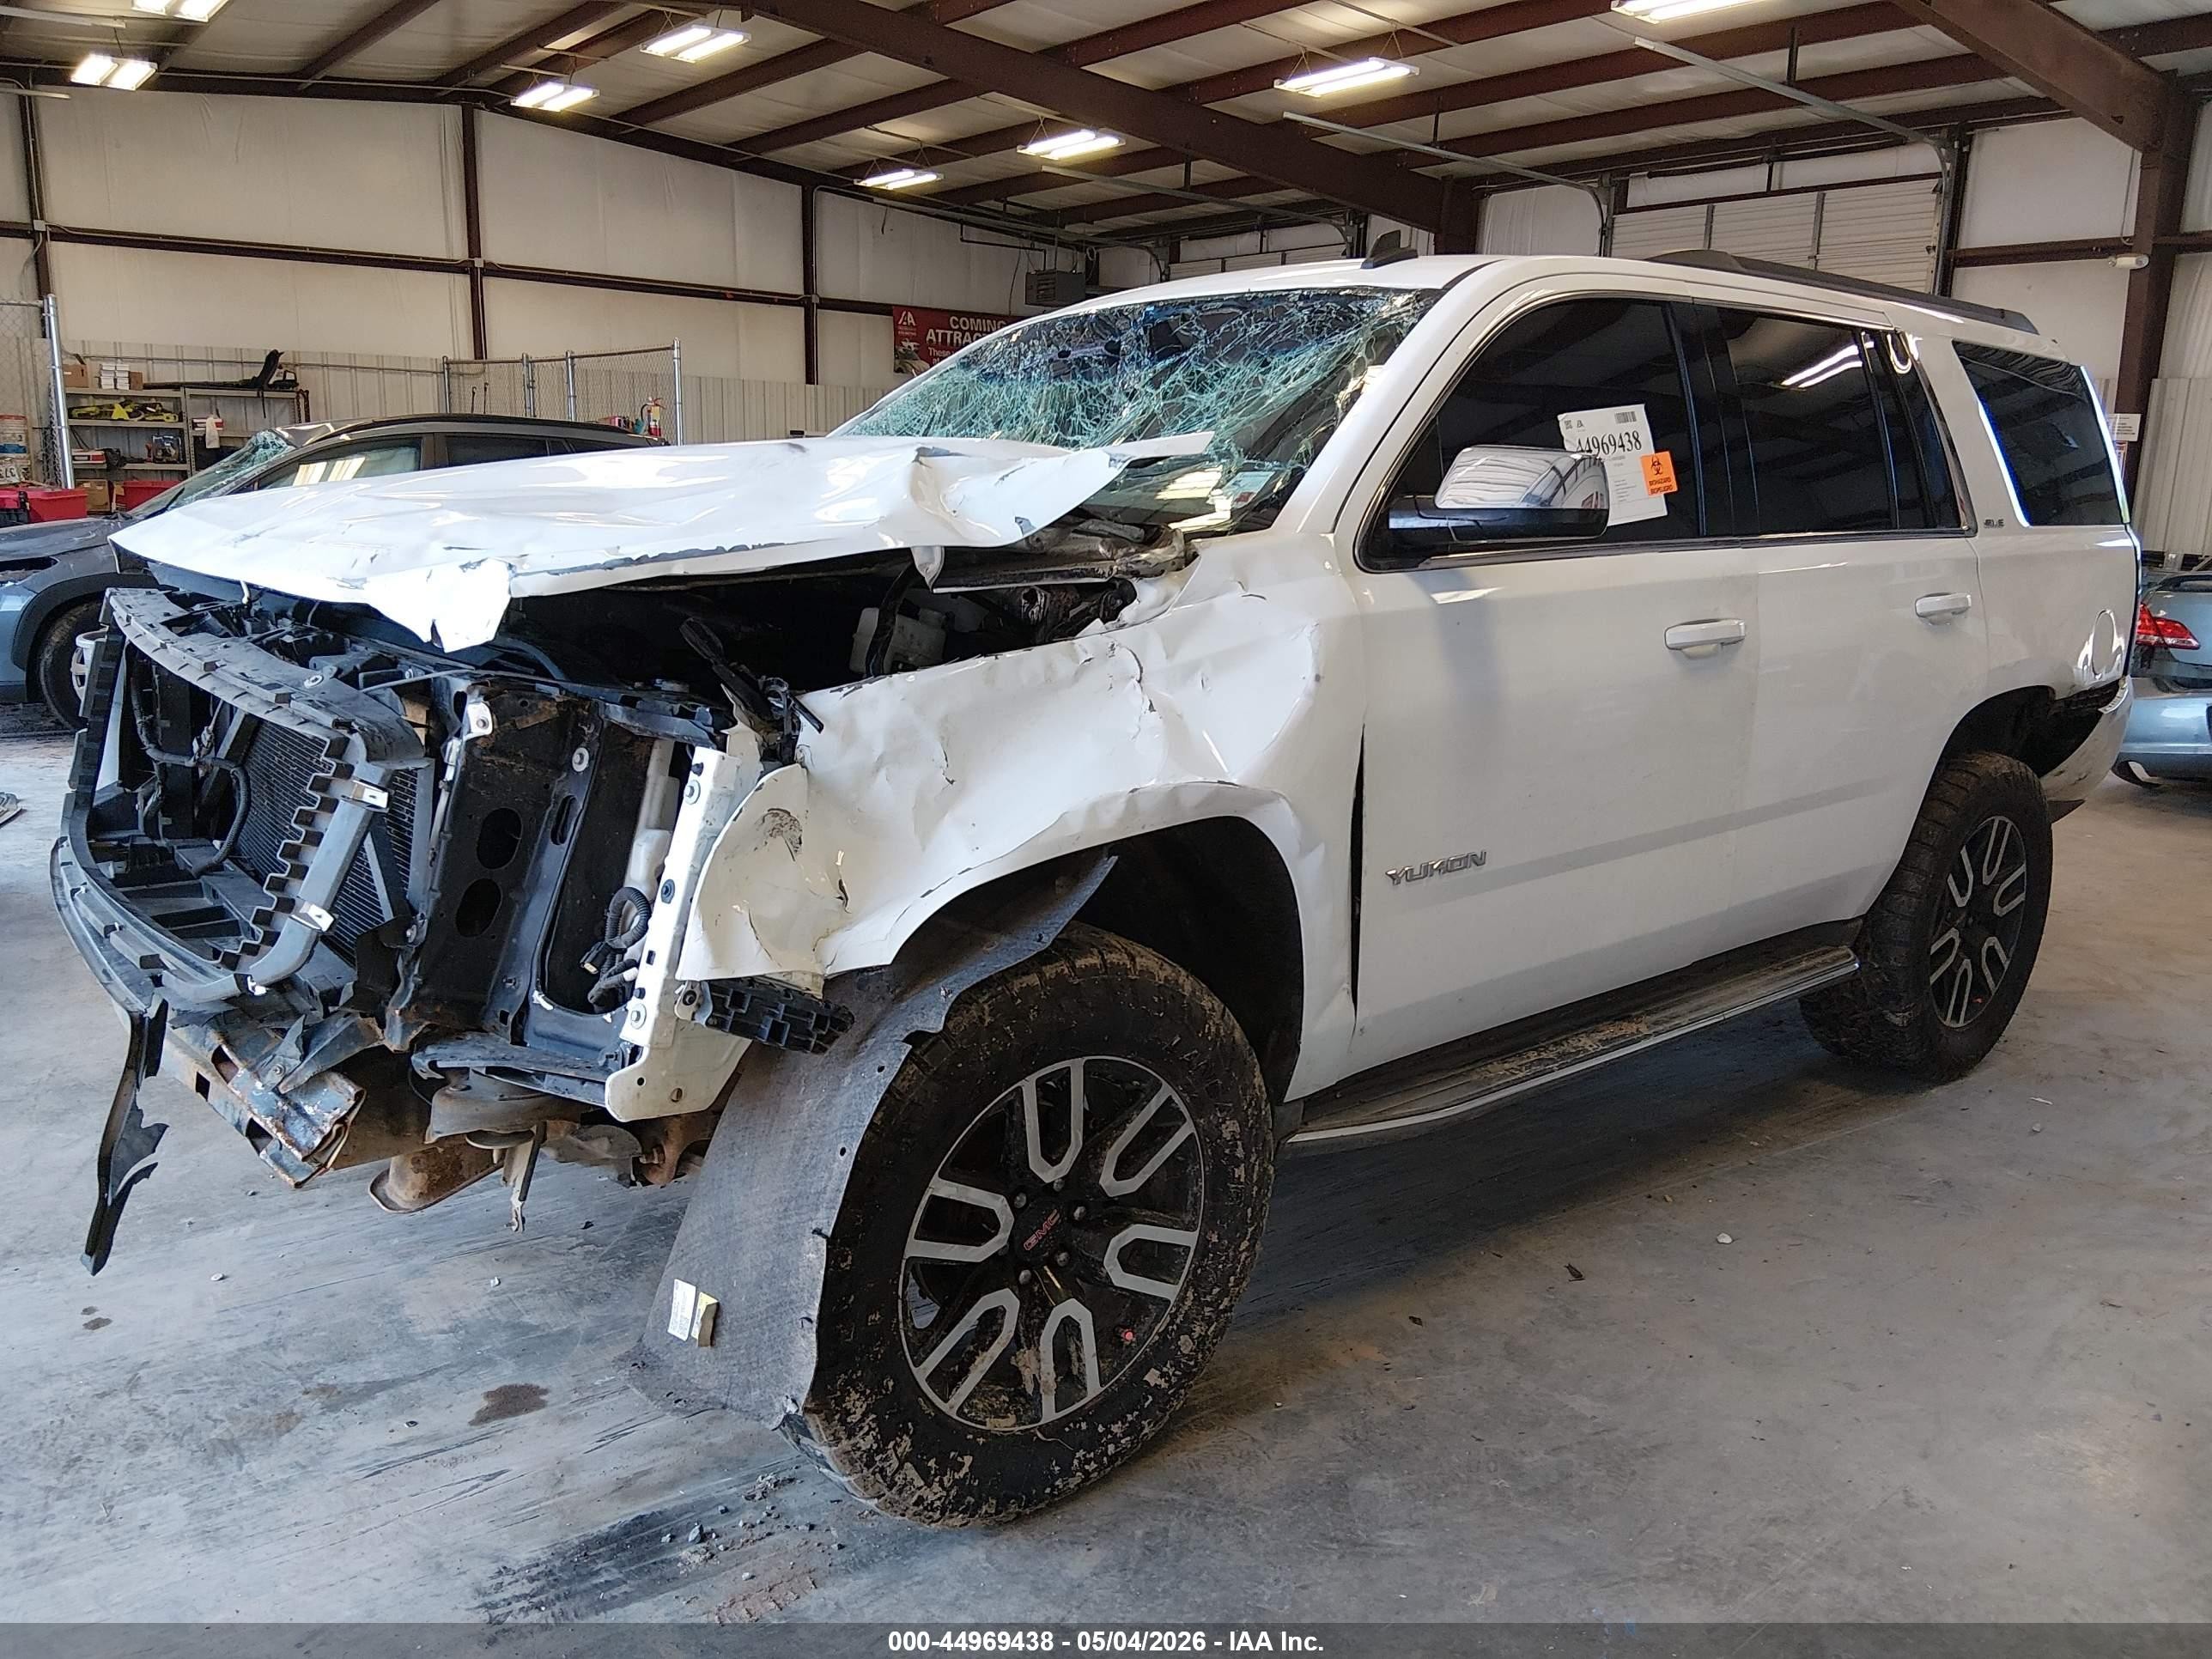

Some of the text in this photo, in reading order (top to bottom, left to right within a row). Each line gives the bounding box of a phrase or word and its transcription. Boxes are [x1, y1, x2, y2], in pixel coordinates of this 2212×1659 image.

[1576, 430, 1642, 458] 44969438
[1385, 850, 1487, 886] YUKON
[1023, 1208, 1061, 1251] GMC
